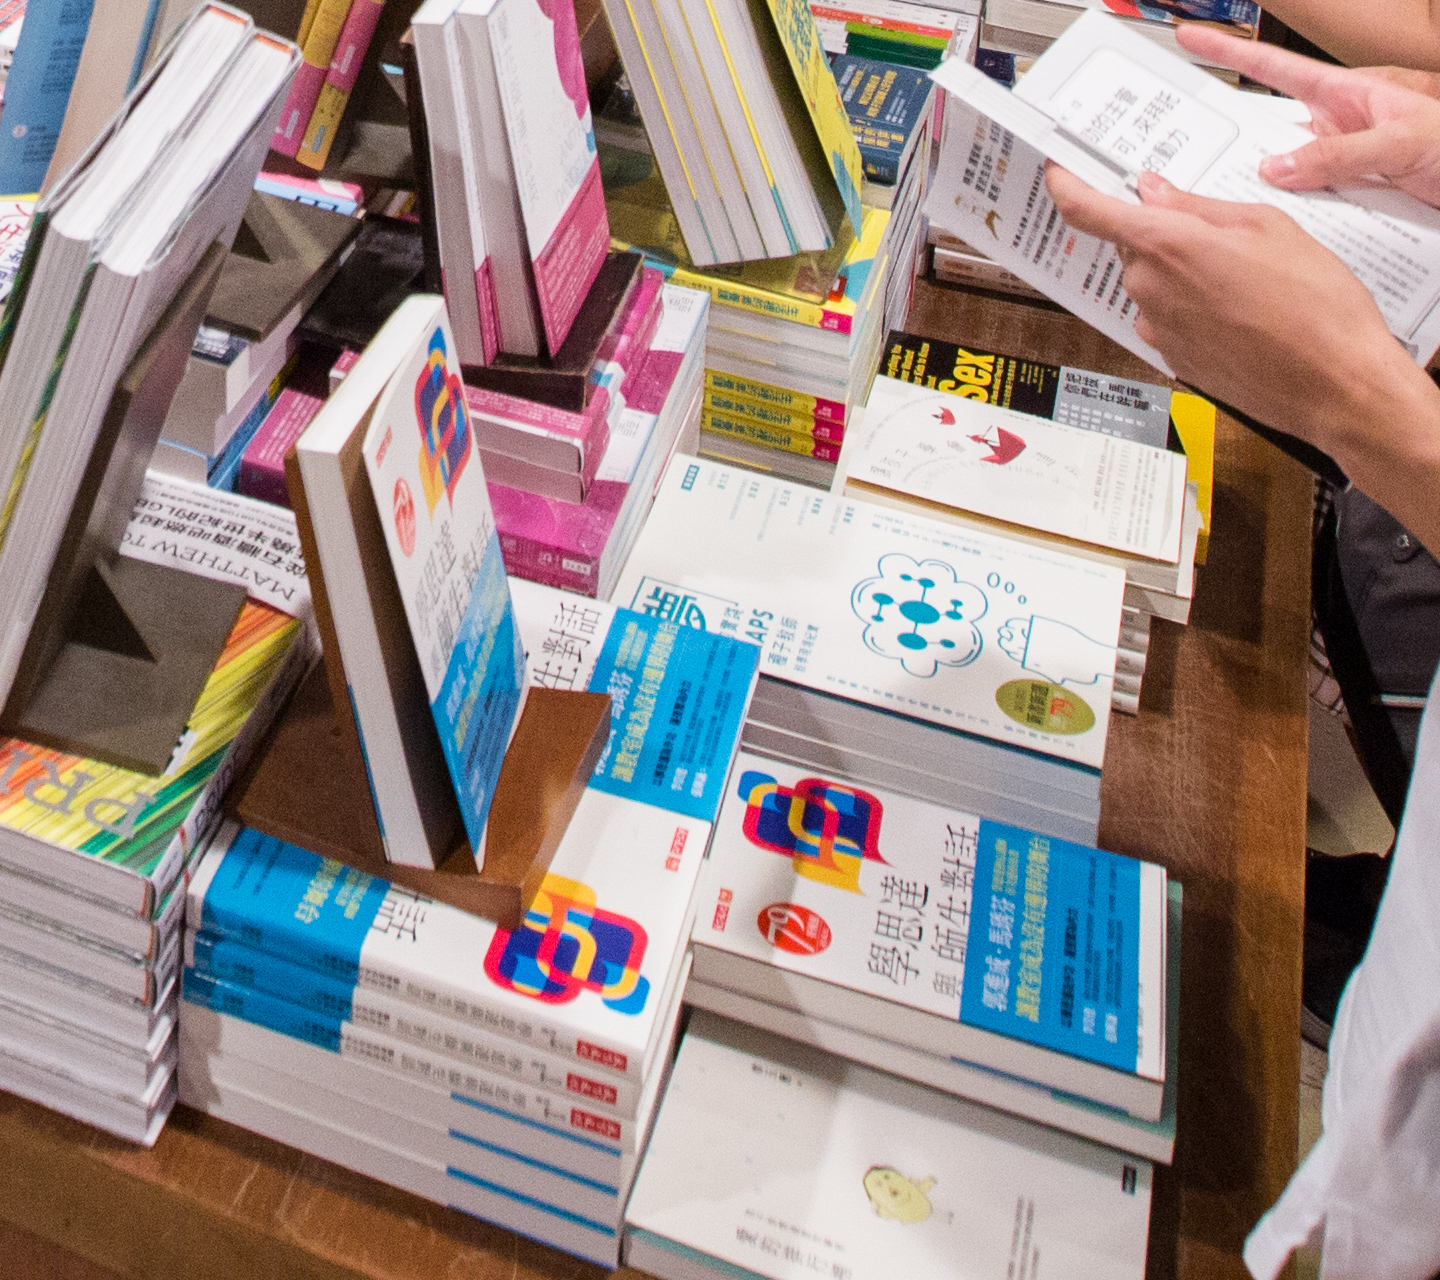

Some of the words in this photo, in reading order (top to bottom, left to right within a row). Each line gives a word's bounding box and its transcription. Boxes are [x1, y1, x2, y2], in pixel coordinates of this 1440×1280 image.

[938, 345, 996, 407] Sex
[146, 534, 298, 603] MATTHEW
[743, 607, 774, 647] APS
[867, 873, 931, 987] 學思達
